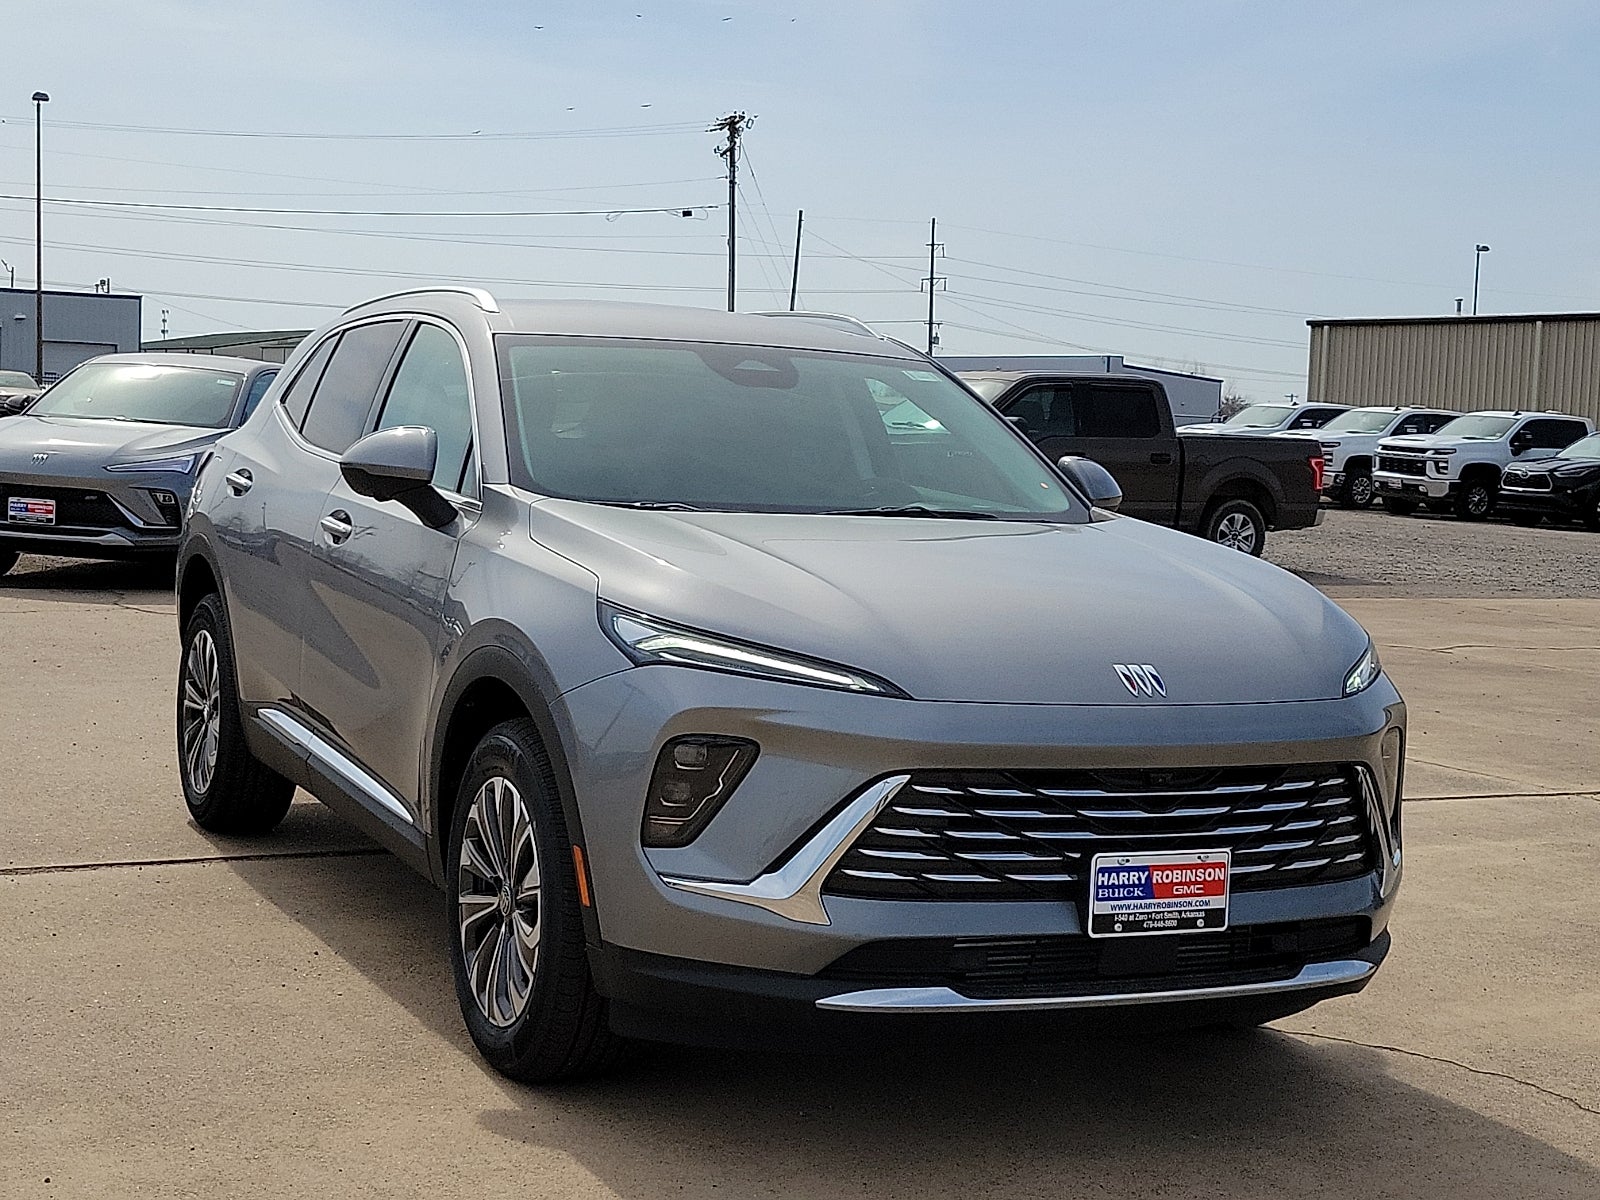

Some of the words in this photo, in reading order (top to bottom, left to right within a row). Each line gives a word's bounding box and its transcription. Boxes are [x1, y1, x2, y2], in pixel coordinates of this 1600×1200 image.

[1097, 871, 1149, 886] HARRY
[1152, 867, 1225, 884] ROBINSON
[1097, 887, 1146, 898] BUICK
[1172, 884, 1205, 895] GMC
[1110, 899, 1211, 912] WWW.HARRYROBINSON.COM
[1135, 913, 1148, 921] Zero
[1152, 912, 1163, 920] Fort
[1181, 910, 1205, 918] Arkansas
